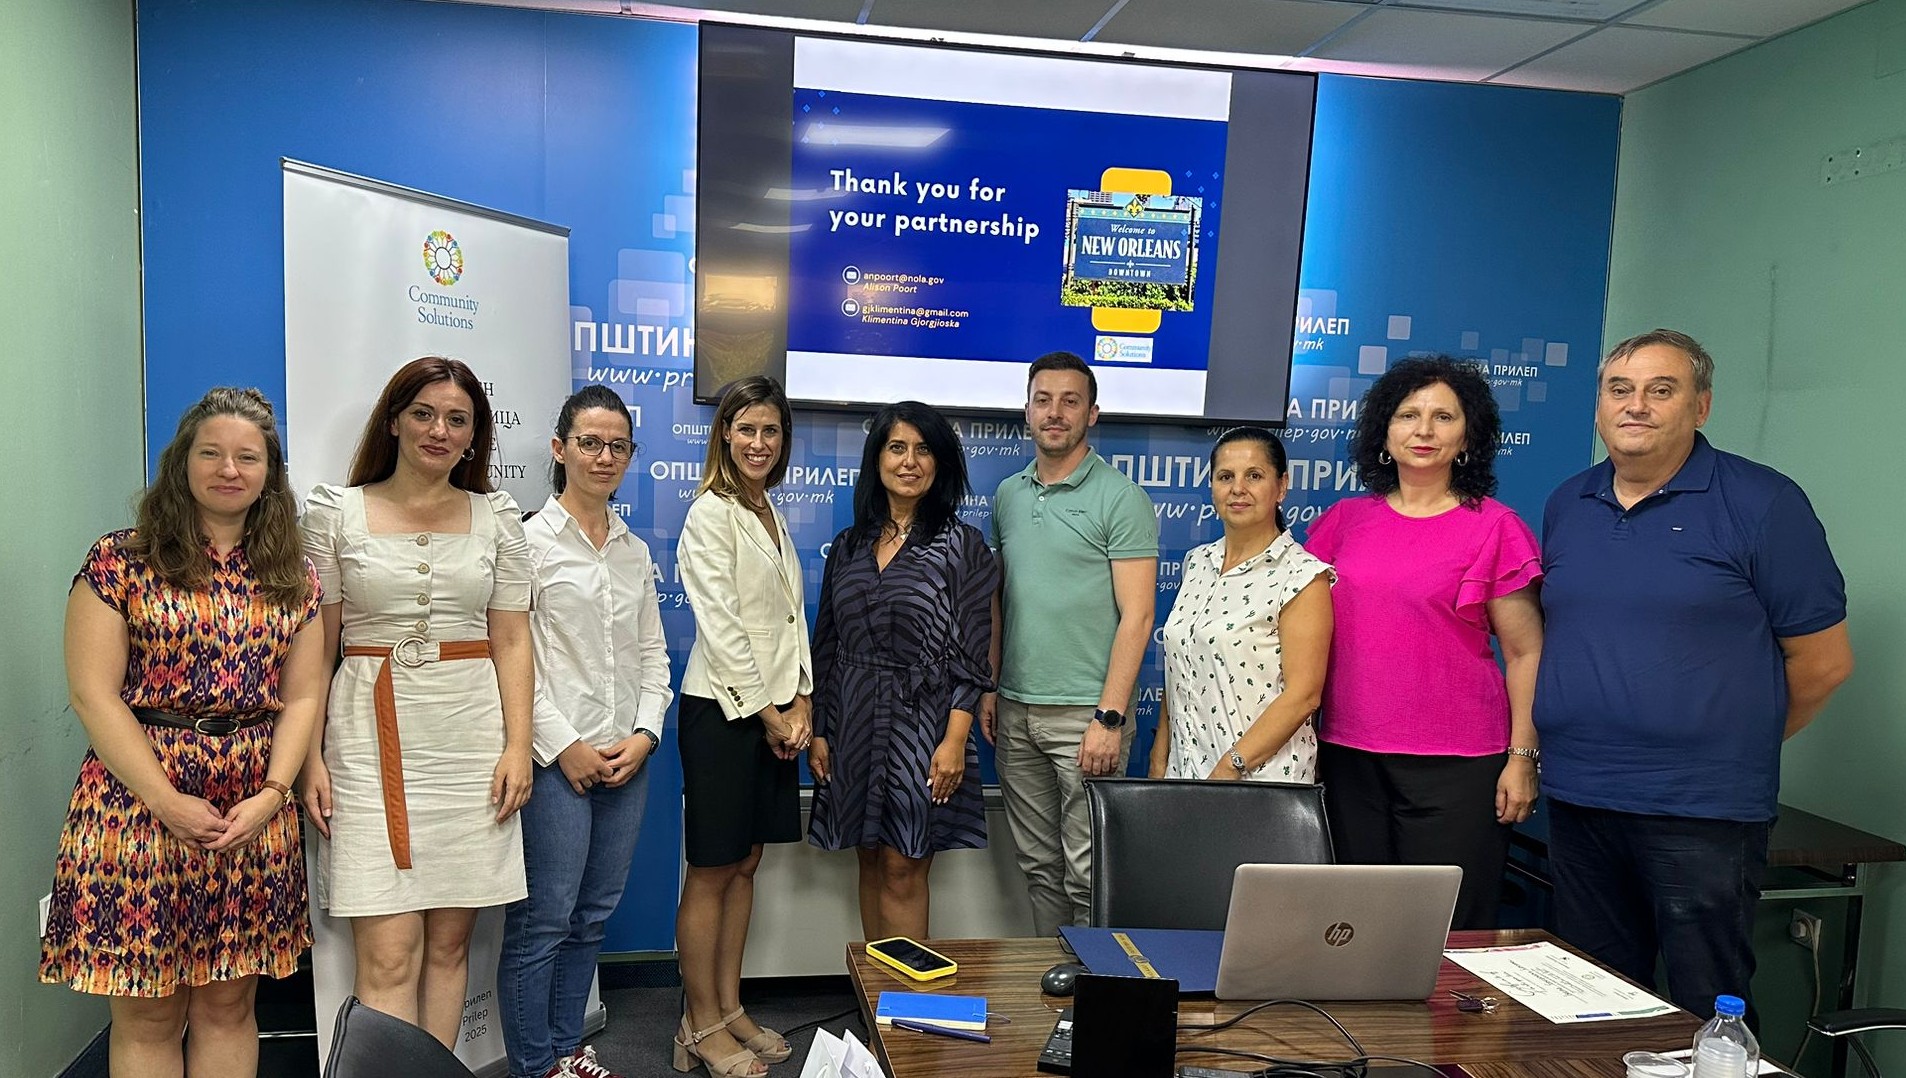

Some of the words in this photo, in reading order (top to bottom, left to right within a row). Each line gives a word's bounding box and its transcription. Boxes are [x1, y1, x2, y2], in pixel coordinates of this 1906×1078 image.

[830, 168, 908, 196] Thank
[916, 182, 960, 204] you
[969, 178, 1006, 202] for
[829, 210, 886, 232] your
[895, 213, 1040, 245] partnership
[1110, 223, 1145, 235] Welcome
[1147, 227, 1156, 235] to
[1081, 235, 1116, 256] NEW
[1117, 237, 1181, 260] ORLEANS
[863, 272, 945, 285] anpoort@nola.gov
[1108, 268, 1152, 278] DOWNTOWN
[863, 283, 891, 293] Alison
[892, 283, 918, 294] Poort
[408, 285, 479, 315] Community
[418, 306, 474, 329] Solutions
[862, 304, 970, 318] gjklimentina@gmail.com
[861, 315, 908, 325] Klimentina
[910, 317, 960, 328] Gjorgjioska
[1493, 364, 1538, 378] ПРИЛЕП
[970, 422, 1032, 440] ПРИЛЕ
[1327, 921, 1351, 947] hp
[464, 990, 492, 1011] рилеп
[463, 1008, 488, 1026] Prilep
[464, 1023, 487, 1042] 2025
